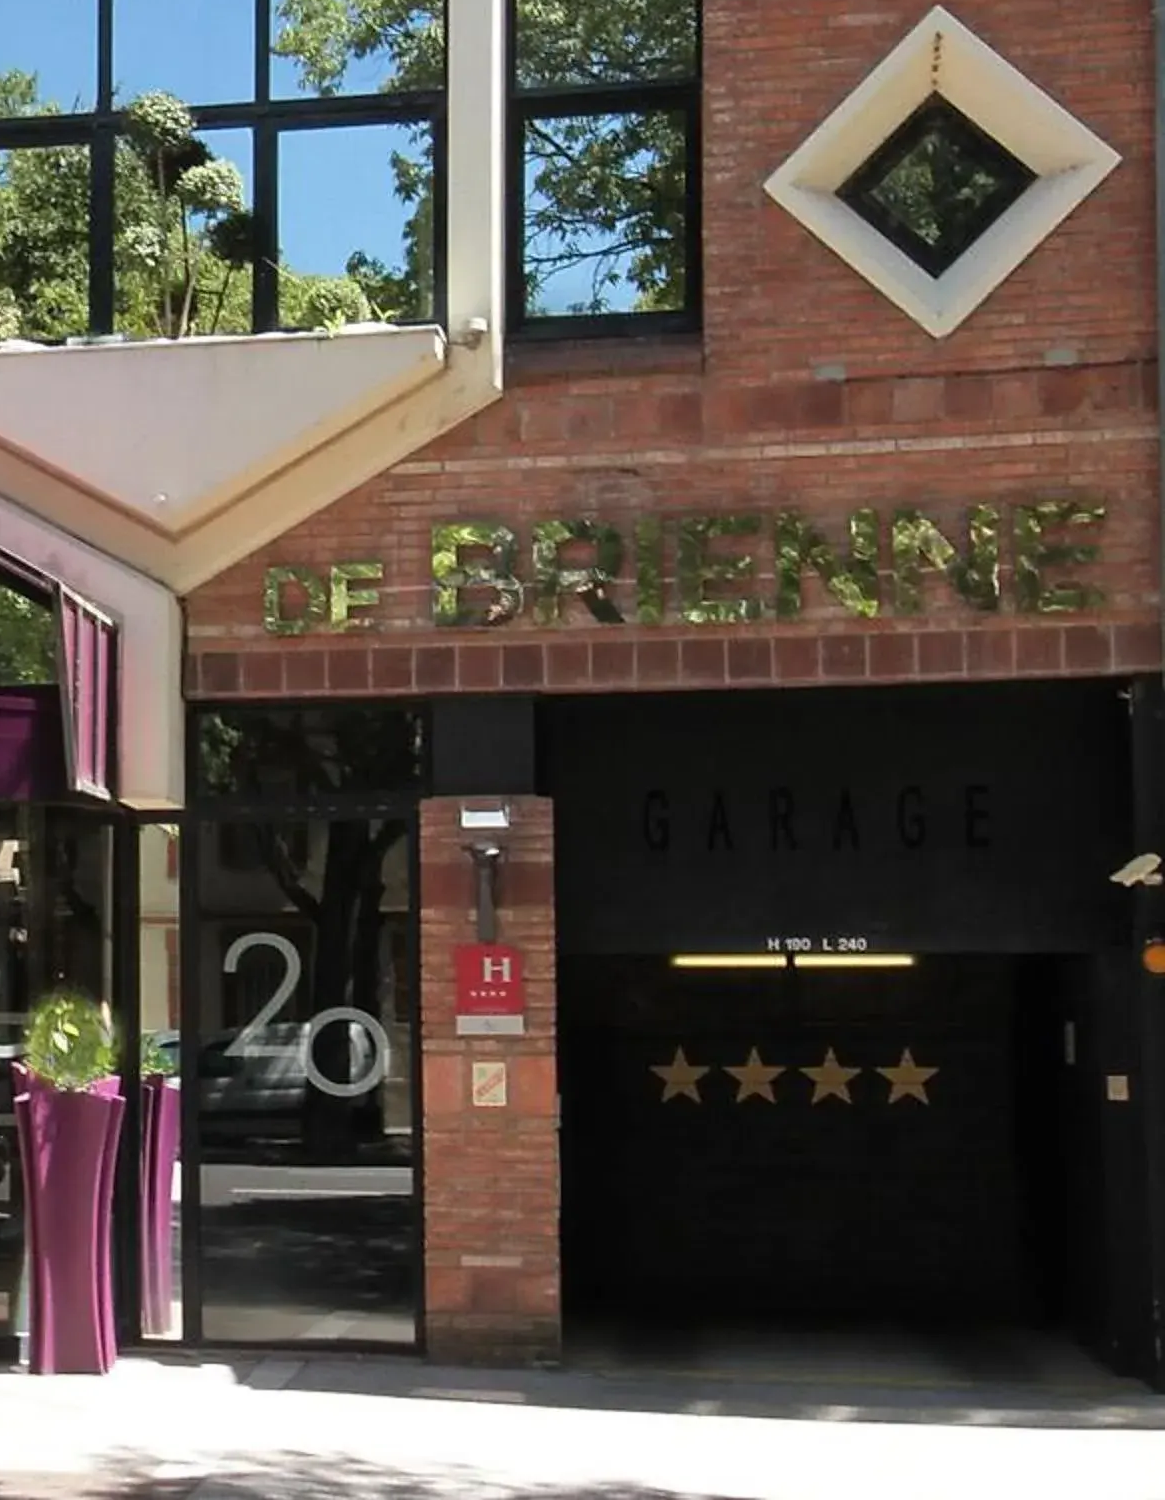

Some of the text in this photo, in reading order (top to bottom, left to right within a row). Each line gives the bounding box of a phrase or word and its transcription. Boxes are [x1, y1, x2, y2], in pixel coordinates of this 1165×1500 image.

[263, 562, 384, 635] DE
[431, 502, 1107, 627] BRIENNE
[642, 784, 994, 852] GARAGE
[483, 957, 511, 982] H
[767, 938, 780, 951] H
[821, 938, 832, 951] L
[838, 937, 867, 951] 240
[223, 932, 391, 1096] 20
